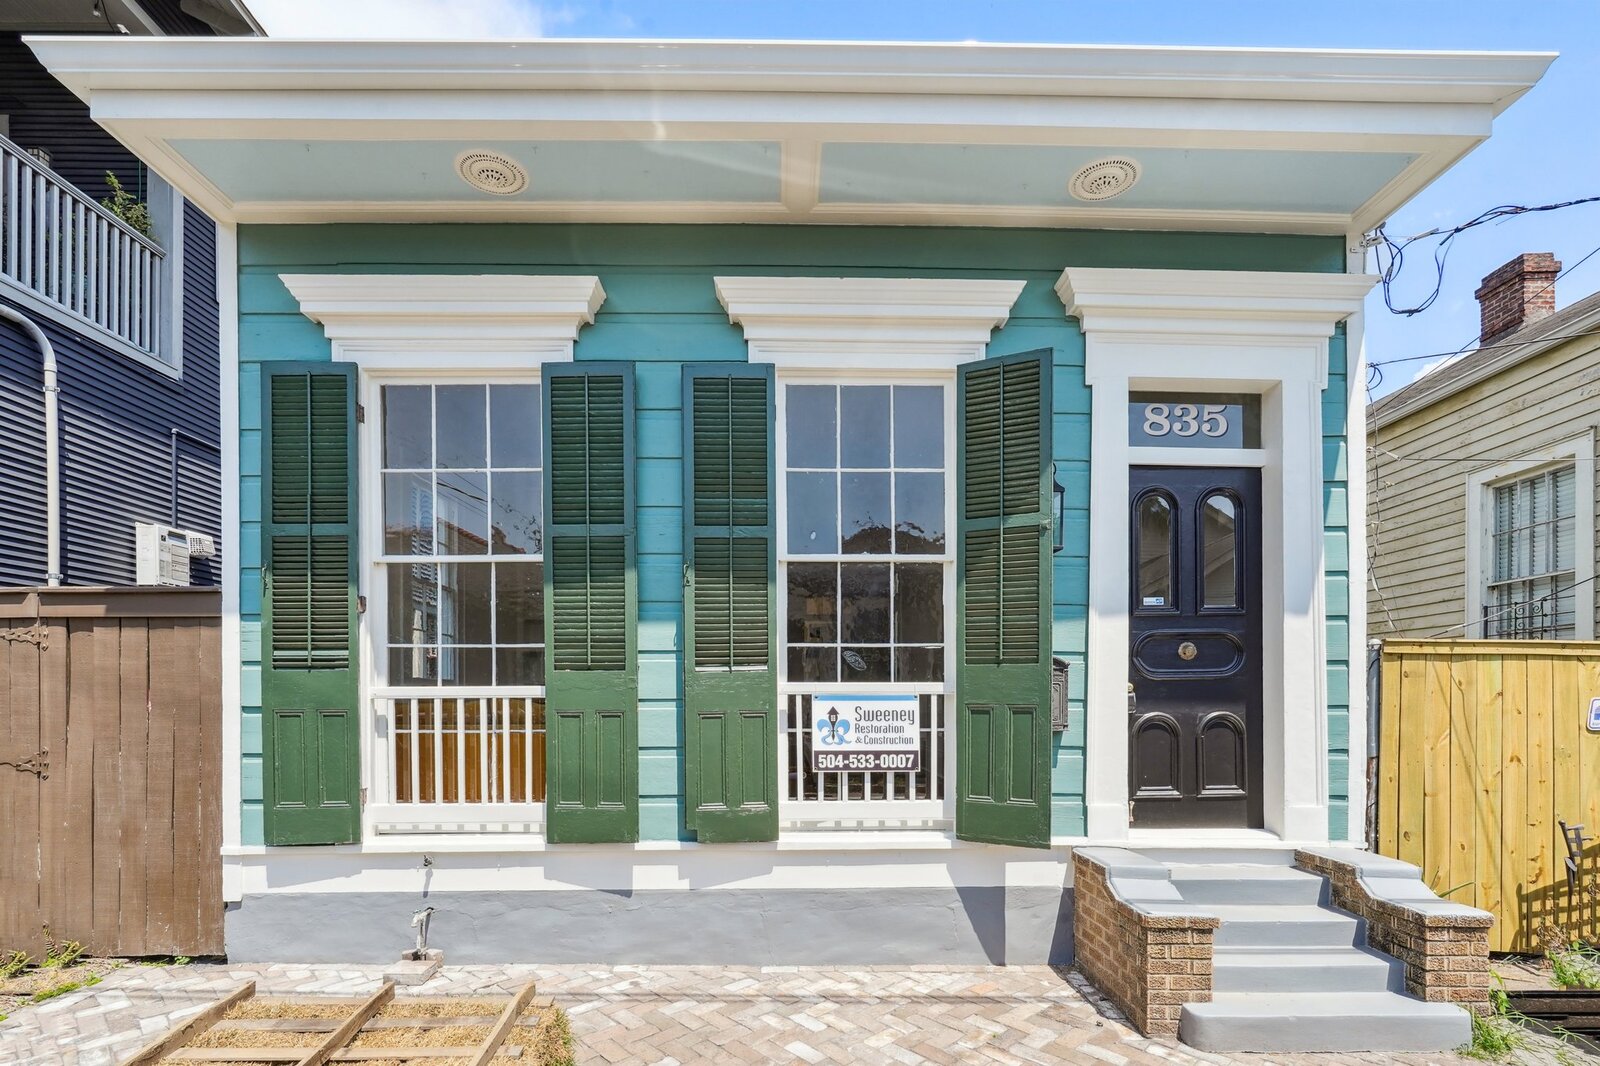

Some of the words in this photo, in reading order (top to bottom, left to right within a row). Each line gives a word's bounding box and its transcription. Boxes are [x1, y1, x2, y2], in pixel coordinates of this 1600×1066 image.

[1143, 403, 1228, 437] 835
[855, 706, 915, 725] Sweeney
[854, 723, 905, 734] Restoration
[863, 735, 914, 745] Construction
[818, 754, 915, 768] 504-533-0007
